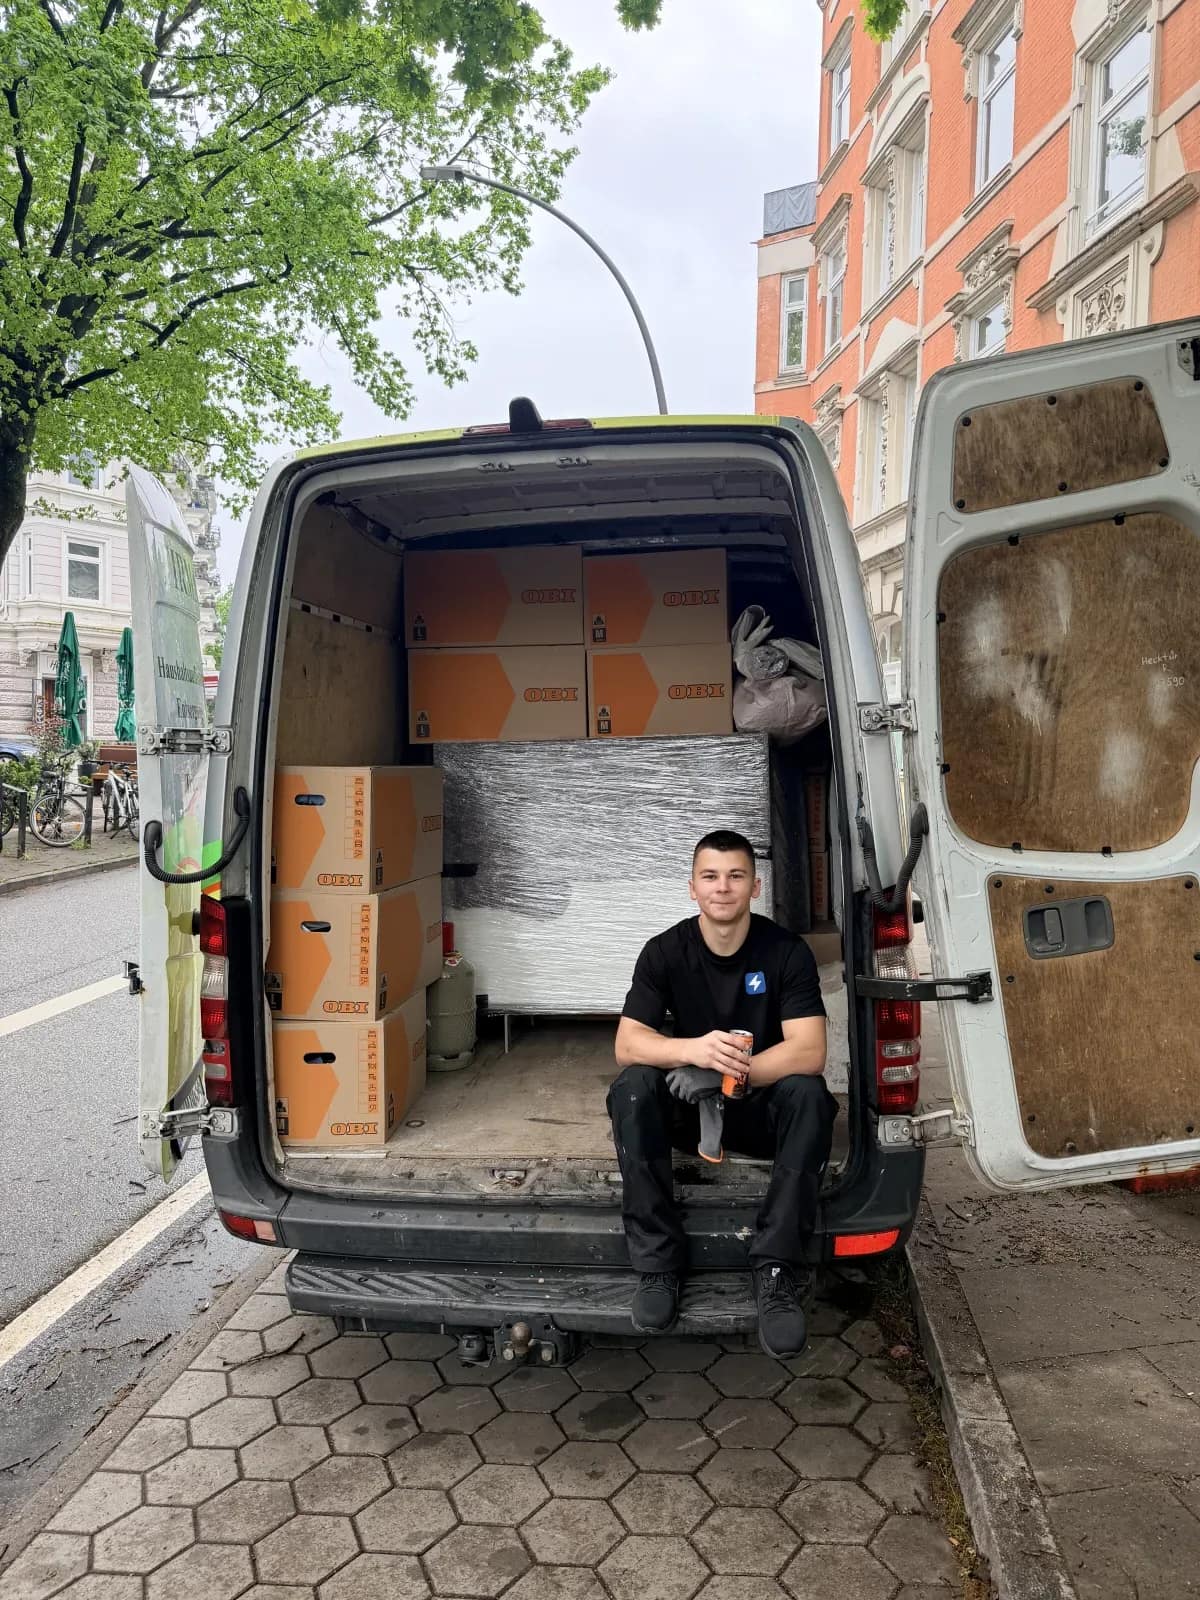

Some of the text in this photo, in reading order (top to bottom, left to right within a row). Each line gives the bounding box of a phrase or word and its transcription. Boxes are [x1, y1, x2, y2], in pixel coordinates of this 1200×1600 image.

[520, 588, 577, 604] OBI
[663, 590, 720, 606] OBI
[523, 687, 578, 702] OBI
[668, 683, 725, 700] OBI
[317, 873, 363, 887] OBI
[322, 1000, 369, 1014] OBI
[330, 1122, 379, 1136] OBI
